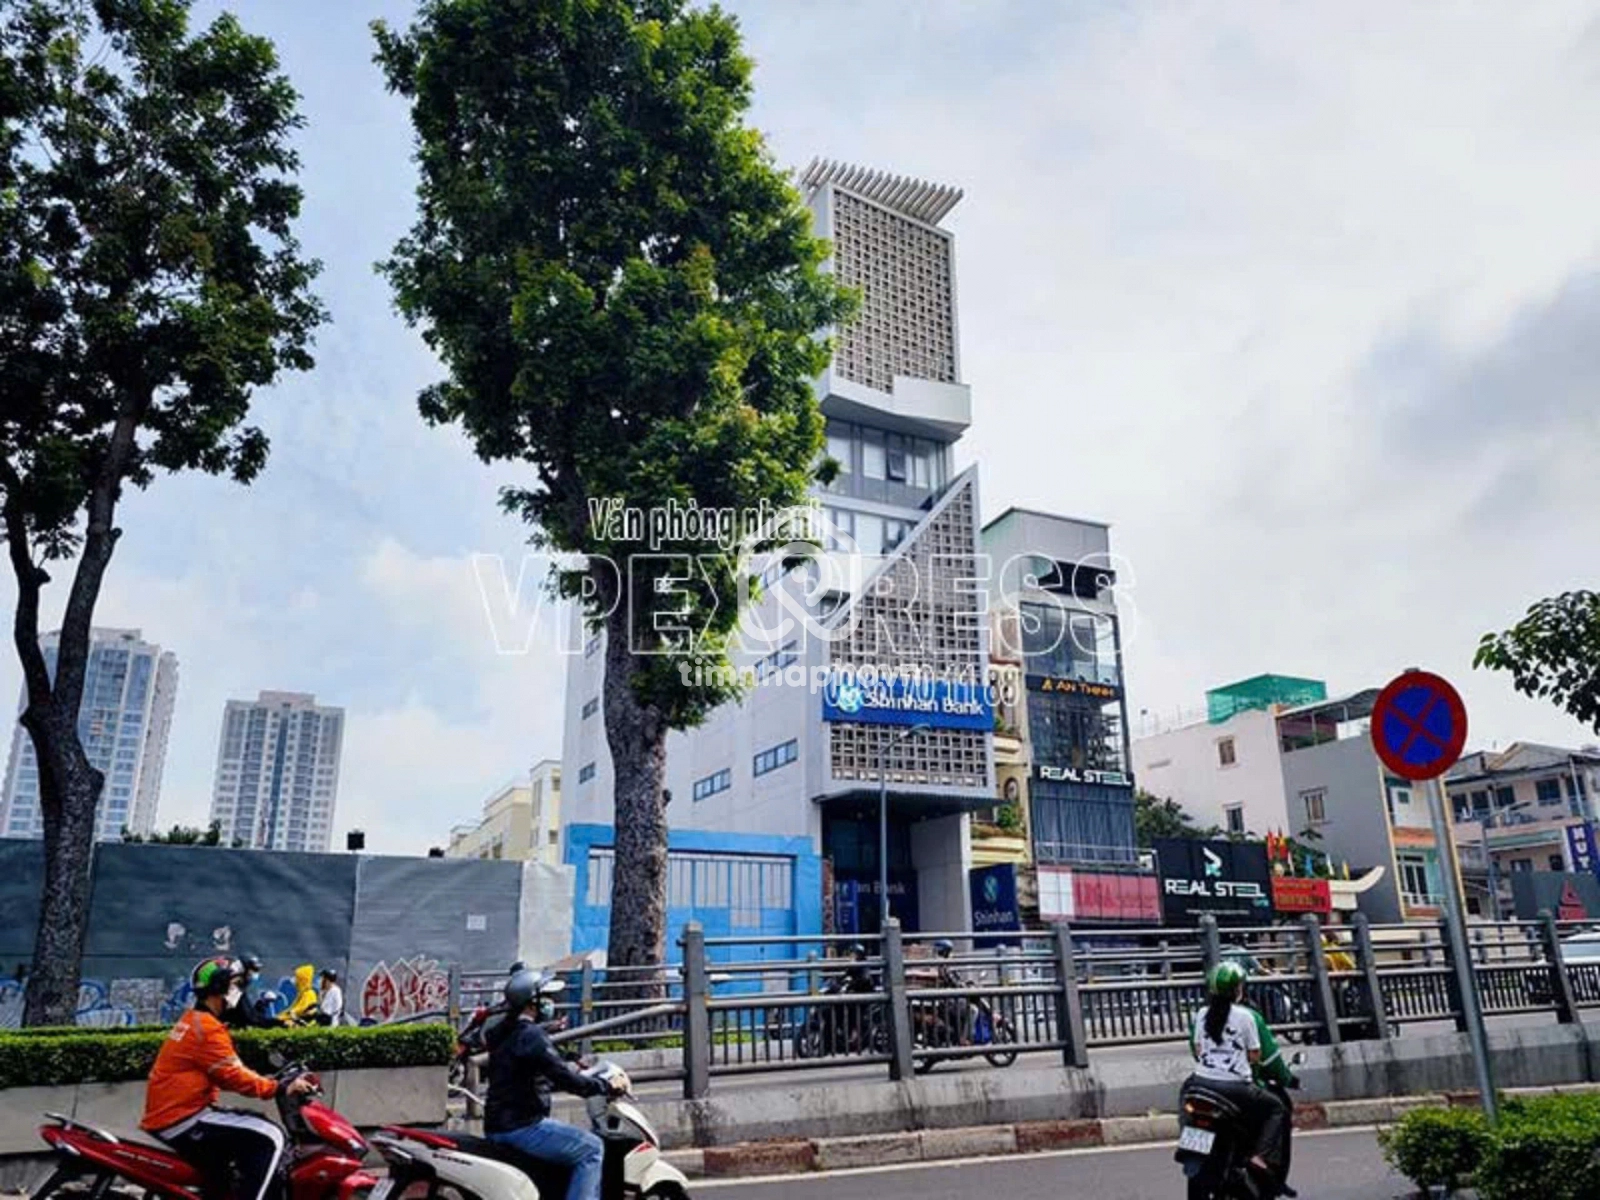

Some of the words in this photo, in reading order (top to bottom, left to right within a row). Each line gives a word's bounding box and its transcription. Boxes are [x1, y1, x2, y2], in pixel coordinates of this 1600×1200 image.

[943, 697, 985, 716] Bank
[1040, 765, 1081, 781] REAL
[1083, 769, 1132, 786] STEEL
[1165, 878, 1211, 897] REAL
[1214, 881, 1267, 898] STEEL
